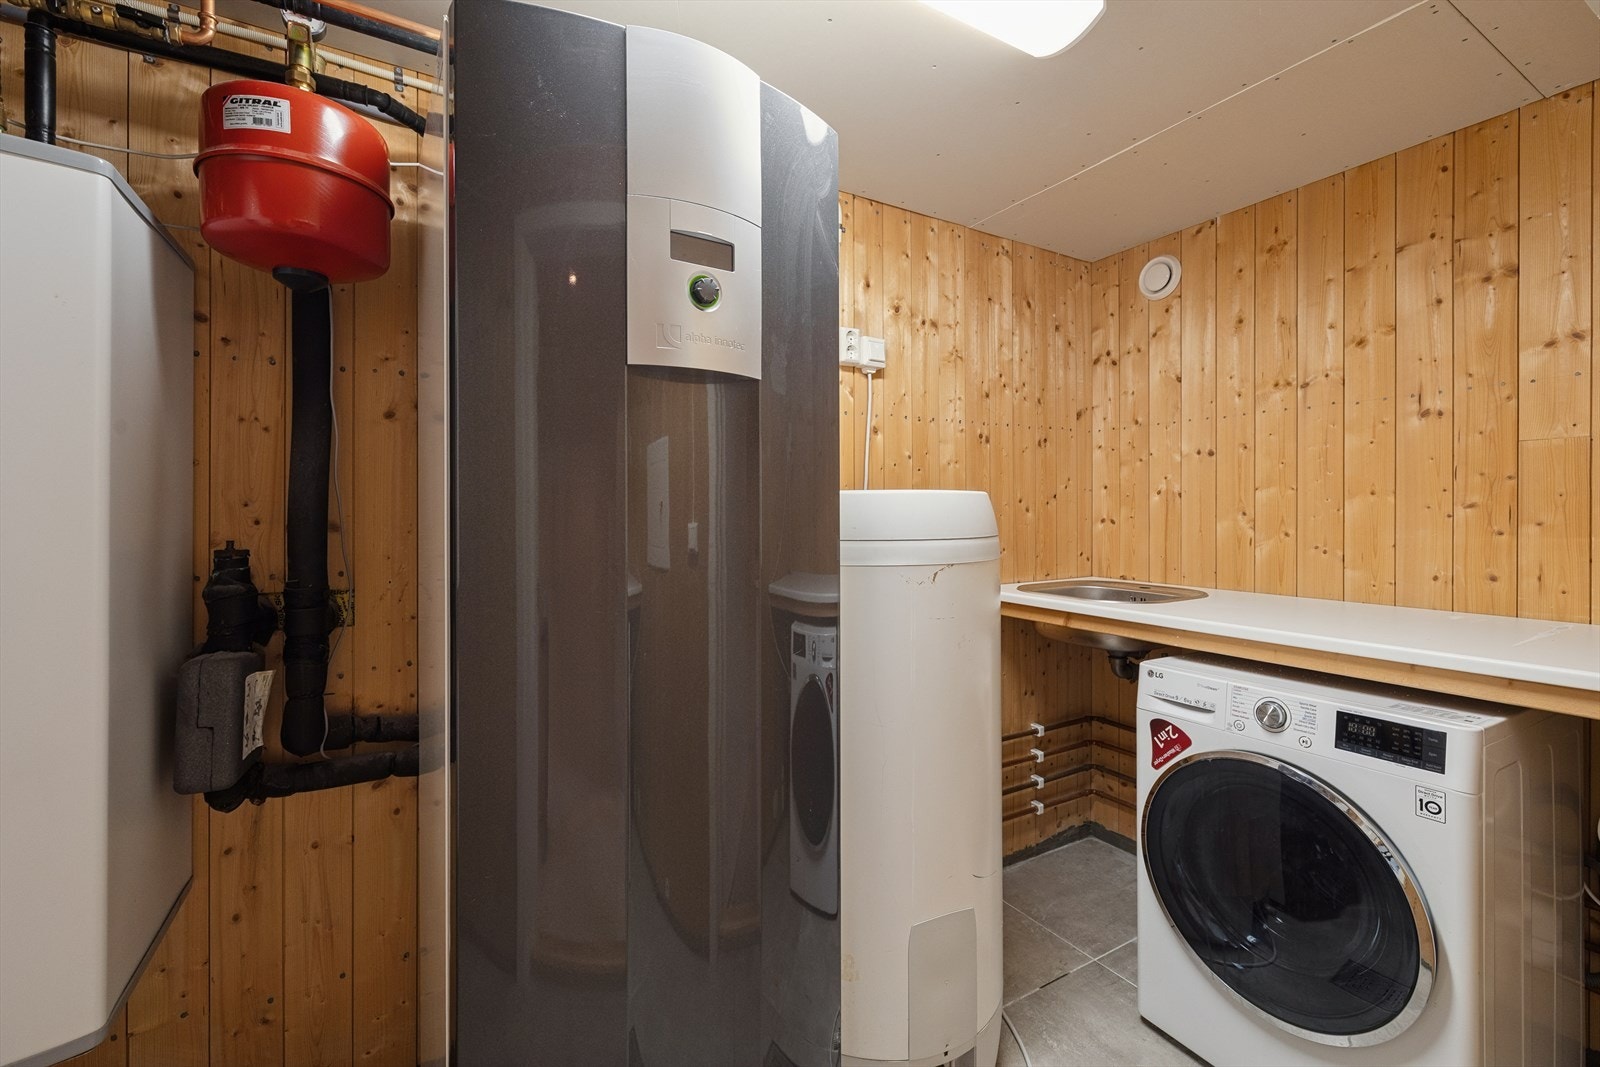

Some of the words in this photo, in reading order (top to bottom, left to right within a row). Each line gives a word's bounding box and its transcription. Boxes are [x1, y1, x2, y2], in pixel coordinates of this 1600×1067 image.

[230, 97, 282, 107] GITRAL
[685, 332, 712, 345] alpha
[1155, 671, 1164, 679] LG
[1153, 725, 1179, 748] 2in1
[1418, 798, 1442, 815] 10
